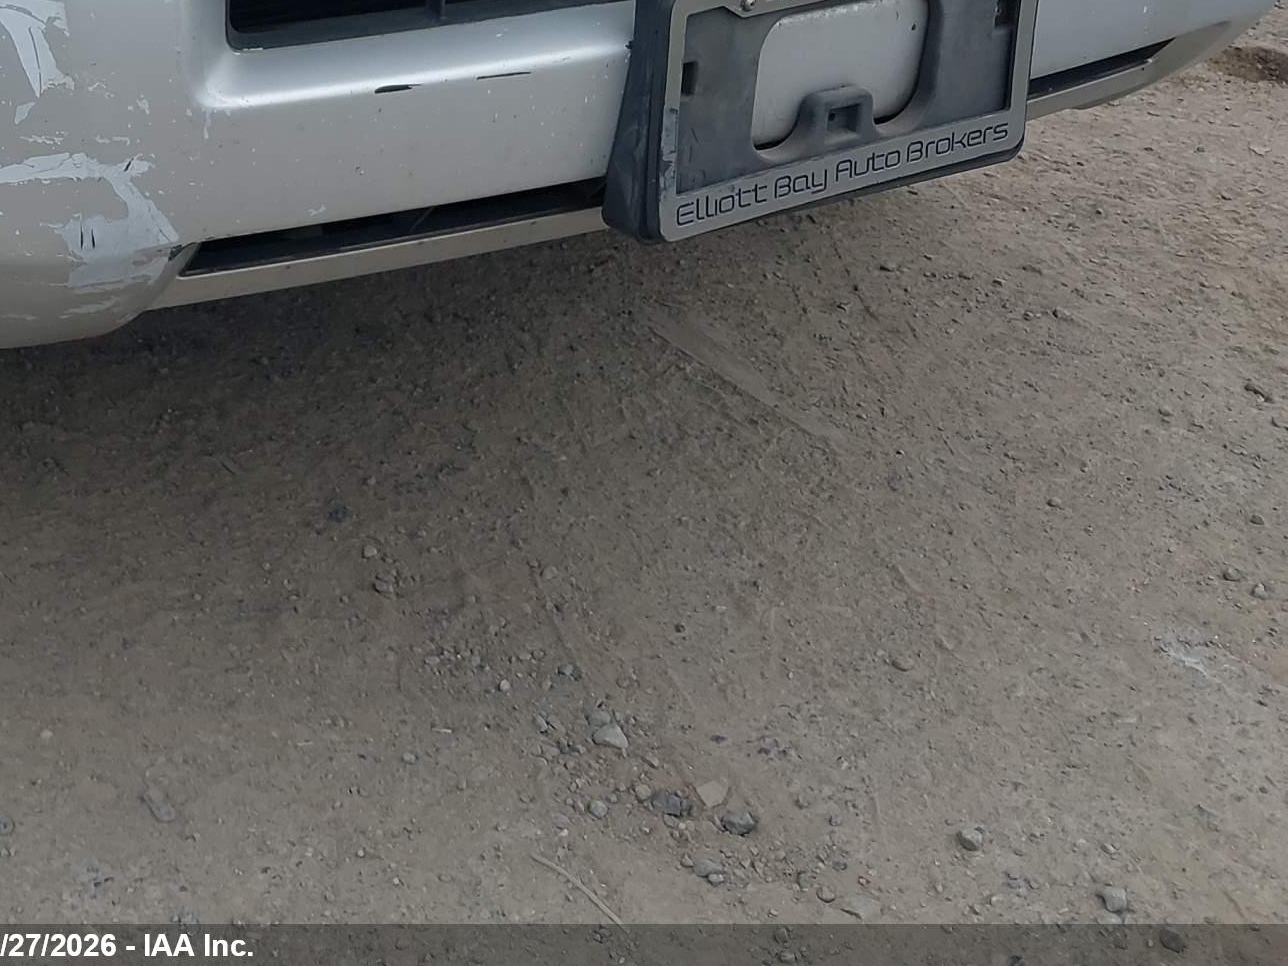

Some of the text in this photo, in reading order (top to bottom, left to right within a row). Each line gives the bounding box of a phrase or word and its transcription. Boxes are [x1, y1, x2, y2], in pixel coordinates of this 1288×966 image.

[675, 122, 1009, 226] Elliott Bay Auto Brokers
